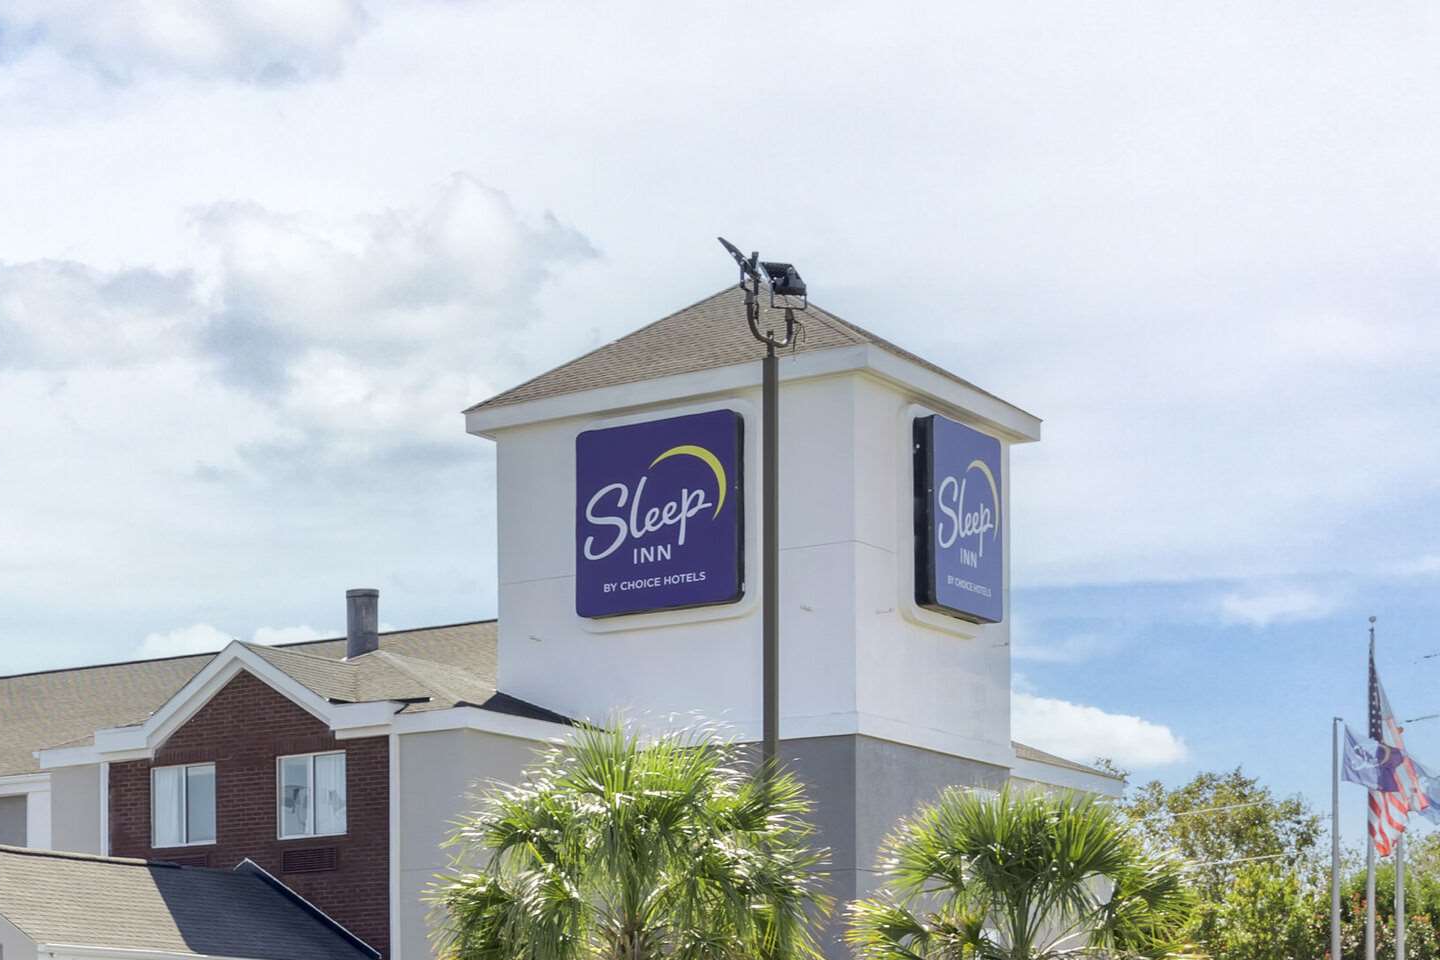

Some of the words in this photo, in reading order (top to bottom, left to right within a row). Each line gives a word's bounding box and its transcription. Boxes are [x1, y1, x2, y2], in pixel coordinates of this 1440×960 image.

[584, 476, 712, 560] Sleep
[938, 476, 994, 558] Sleep
[633, 543, 671, 565] INN
[960, 547, 978, 568] INN
[603, 583, 618, 593] BY
[620, 577, 661, 591] CHOICE
[663, 571, 706, 586] HOTELS
